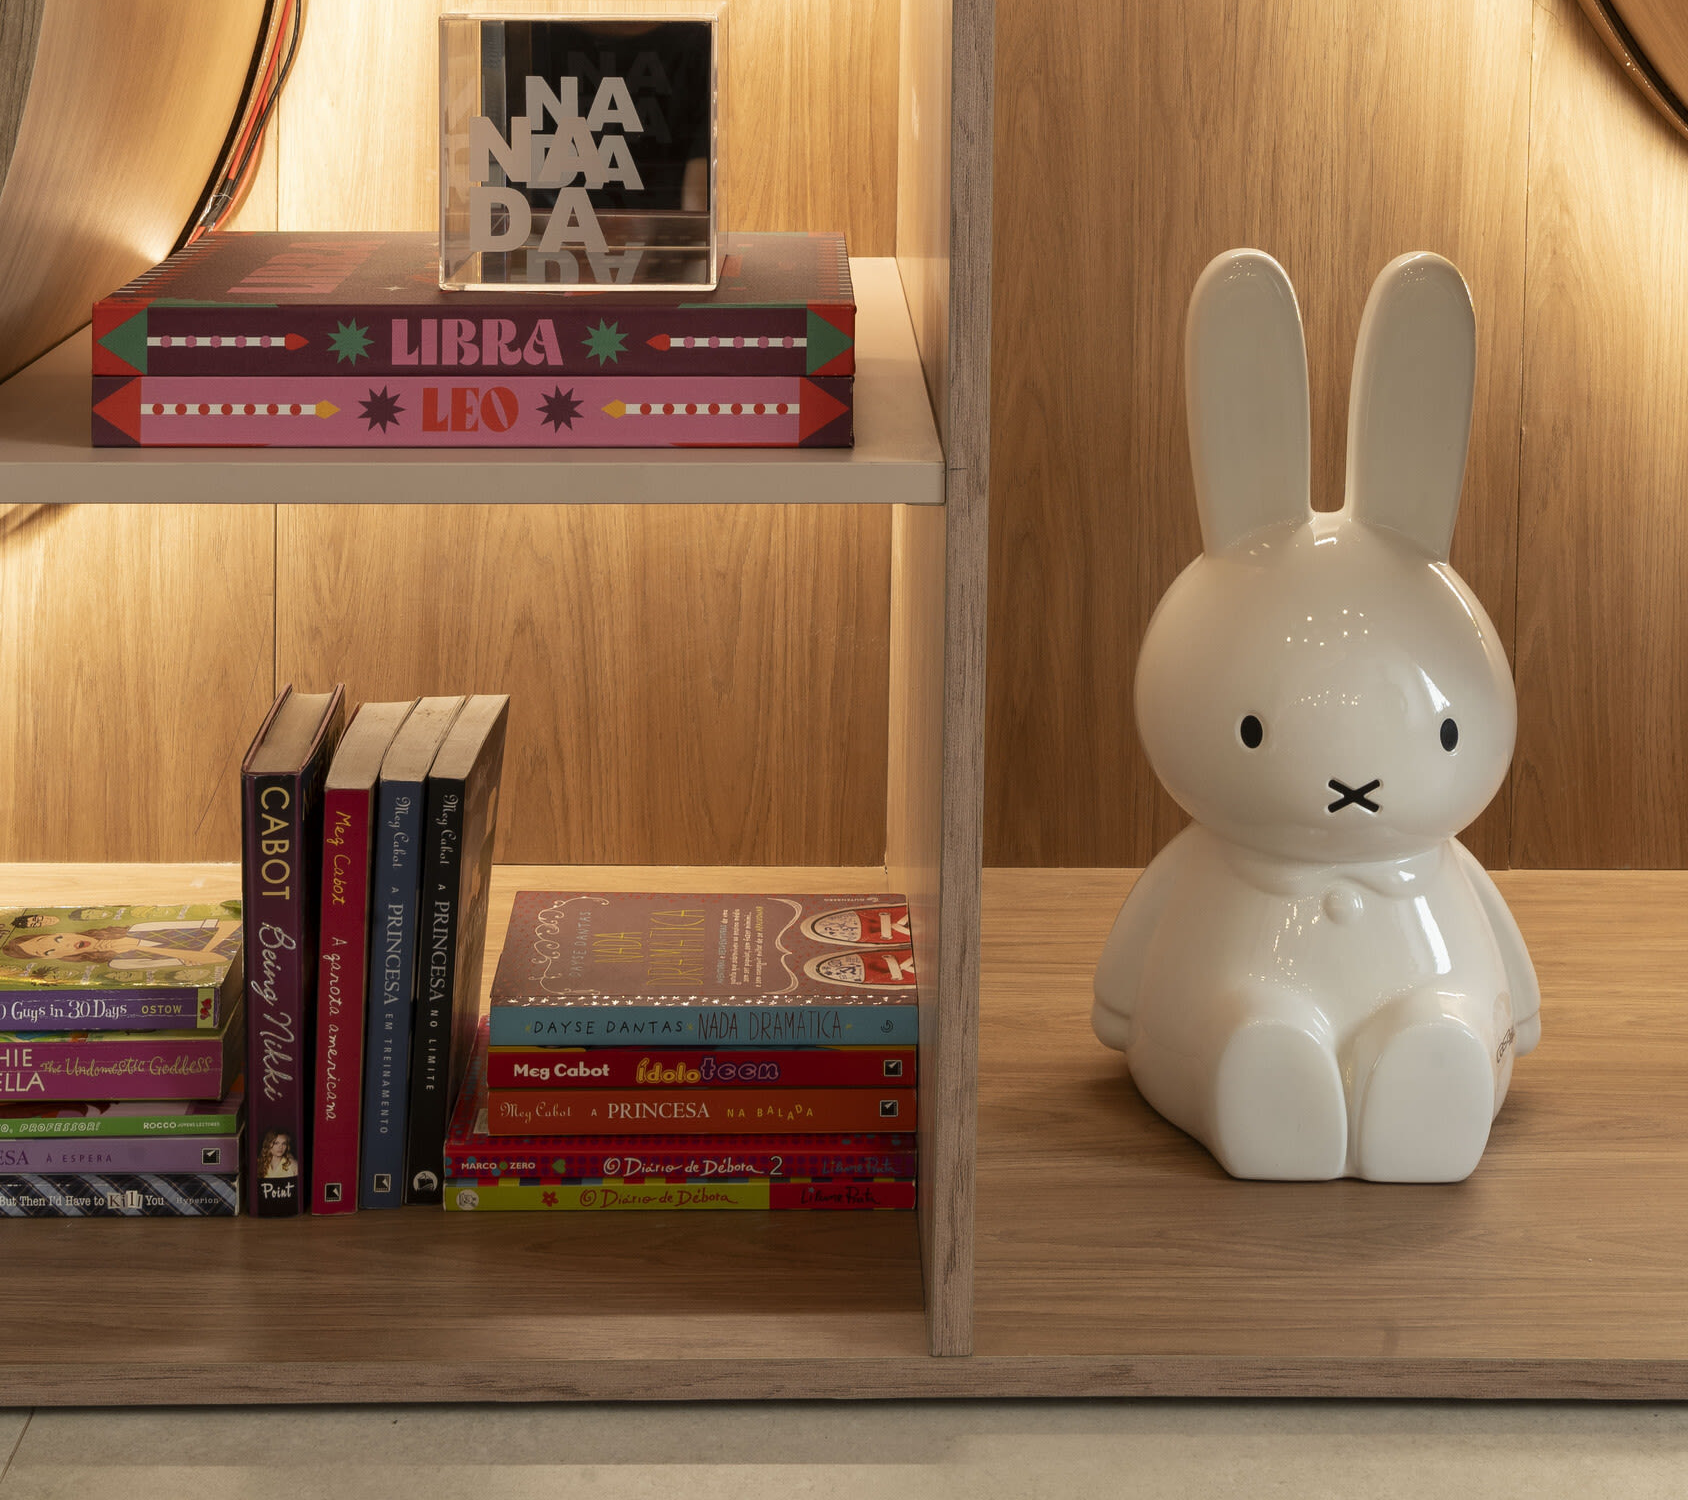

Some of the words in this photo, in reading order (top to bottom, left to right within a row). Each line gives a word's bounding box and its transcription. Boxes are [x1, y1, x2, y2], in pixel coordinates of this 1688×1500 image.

[525, 76, 644, 132] NA
[469, 116, 609, 182] NA
[469, 186, 609, 252] DA
[391, 318, 564, 366] LIBRA
[421, 386, 519, 432] LEO
[388, 796, 411, 828] Meg
[435, 794, 458, 825] Meg
[261, 786, 290, 900] CABOT
[327, 811, 351, 846] Meg
[392, 832, 409, 868] Cabot
[439, 829, 457, 865] Cabot
[333, 854, 351, 905] Cabot
[438, 883, 446, 891] A
[331, 937, 348, 947] A
[575, 911, 591, 948] DANTAS
[383, 904, 404, 1005] PRINCESA
[429, 900, 450, 1001] PRINCESA
[592, 932, 644, 963] NADA
[251, 921, 296, 1007] Being
[323, 953, 343, 1016] garota
[11, 1001, 46, 1023] Guys
[50, 1004, 64, 1017] in
[68, 999, 91, 1019] 30
[93, 1000, 127, 1023] Days
[141, 1005, 182, 1014] OSTOW
[385, 1013, 394, 1030] EM
[429, 1009, 439, 1028] NO
[534, 1021, 595, 1035] DAYSE
[607, 1021, 684, 1034] DANTAS
[698, 1011, 738, 1041] NADA
[40, 1060, 61, 1074] The
[65, 1057, 145, 1076] Undomestic
[150, 1056, 212, 1075] Goddess
[260, 1012, 295, 1101] Nikki
[426, 1039, 437, 1091] LIMITE
[514, 1063, 549, 1080] Meg
[554, 1061, 610, 1077] Cabot
[636, 1057, 701, 1084] ídolo
[699, 1055, 781, 1083] teen
[0, 1071, 45, 1091] LLA
[326, 1023, 341, 1121] americana
[380, 1039, 393, 1134] TREINAMENTO
[143, 1122, 176, 1130] ROCCO
[500, 1101, 532, 1124] Meg
[535, 1101, 572, 1118] Cabot
[591, 1108, 598, 1117] A
[607, 1102, 710, 1119] PRINCESA
[727, 1108, 745, 1118] NA
[757, 1103, 813, 1120] BALADA
[20, 1122, 101, 1133] PROFESSOR!
[62, 1154, 112, 1164] ESPERA
[461, 1162, 497, 1170] MARCO
[510, 1161, 536, 1170] ZERO
[623, 1157, 683, 1177] Diário
[685, 1160, 699, 1173] de
[700, 1157, 764, 1176] Débora
[769, 1155, 783, 1176] 2
[20, 1196, 46, 1207] Then
[49, 1195, 62, 1207] I'd
[65, 1195, 91, 1206] Have
[94, 1196, 104, 1206] to
[145, 1195, 164, 1206] You
[176, 1197, 219, 1205] Hyperion
[261, 1182, 295, 1199] Point
[600, 1189, 656, 1208] Diário
[659, 1190, 673, 1204] de
[674, 1188, 738, 1206] Débora
